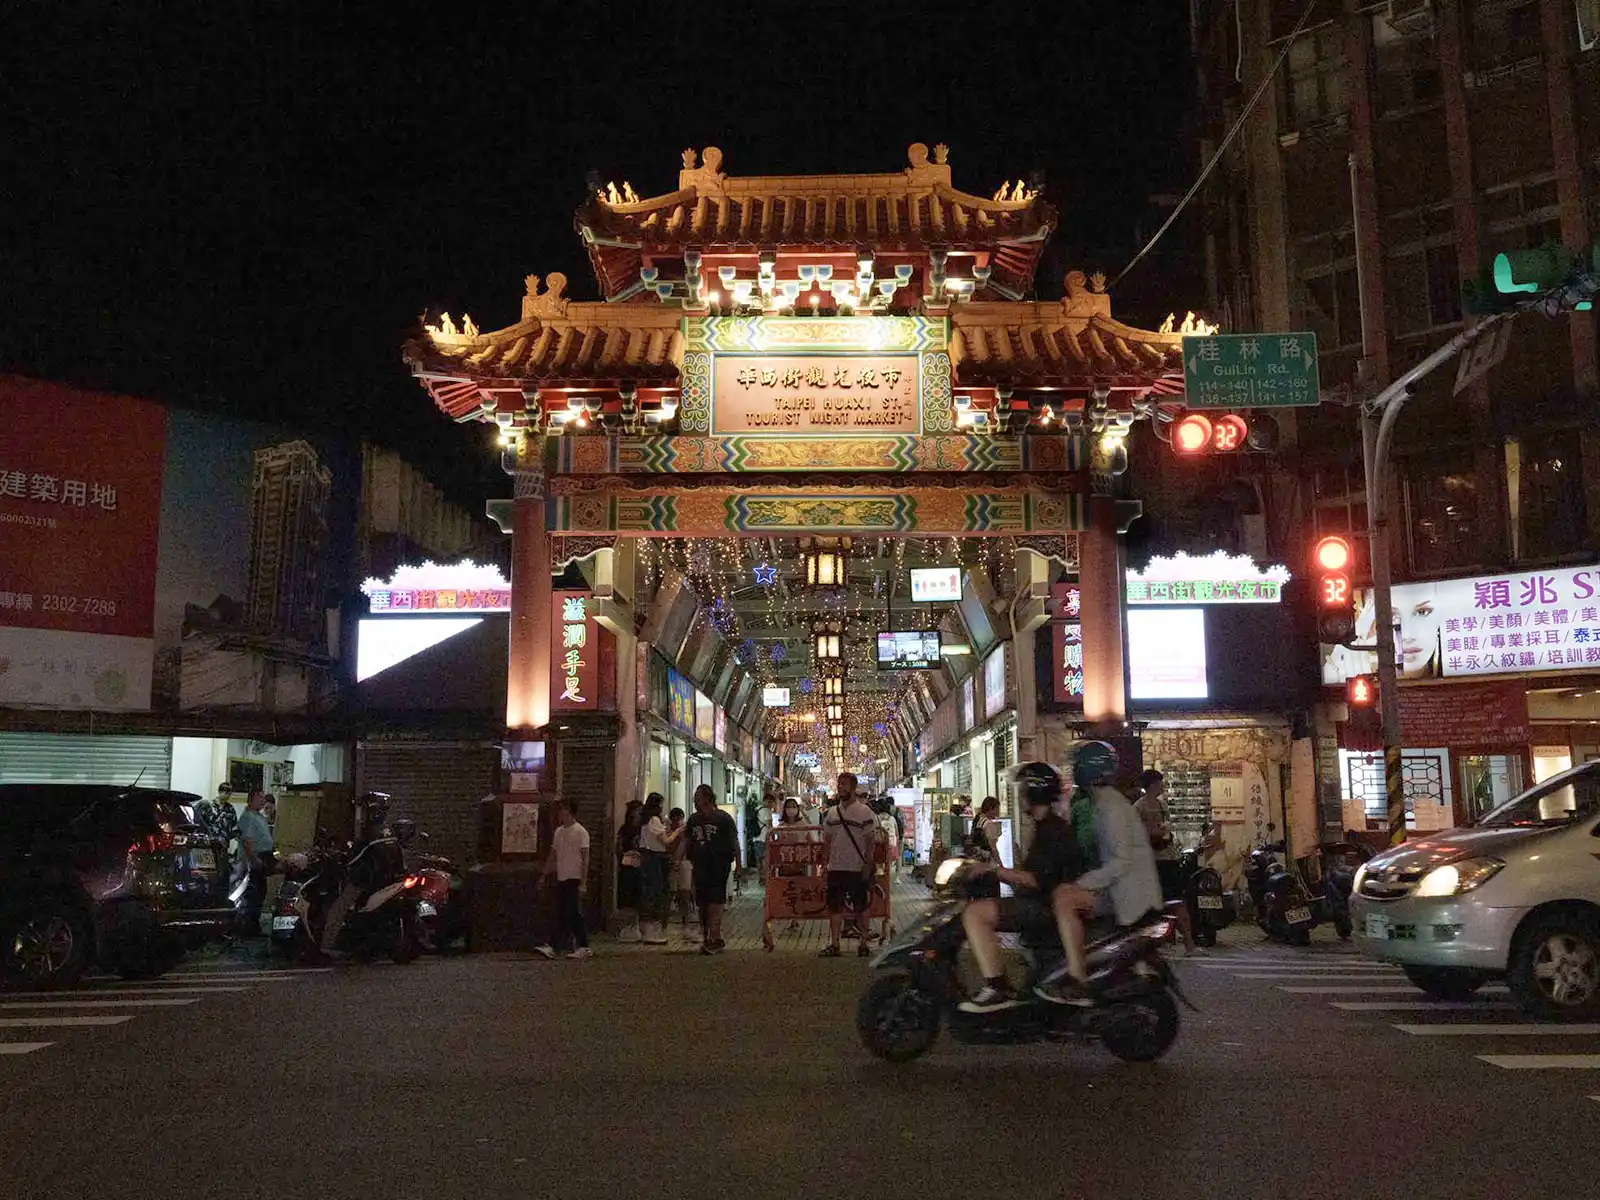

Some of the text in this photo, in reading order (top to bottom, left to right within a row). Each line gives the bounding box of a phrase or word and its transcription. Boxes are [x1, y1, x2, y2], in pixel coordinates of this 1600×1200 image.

[1197, 338, 1301, 361] 桂林路
[737, 365, 902, 390] 華西街觀光夜市
[1267, 363, 1290, 375] Rd.
[775, 398, 902, 411] TAIPEI HUAXI ST.
[746, 411, 904, 426] TOURIST NIGHT MARKET
[1215, 424, 1238, 448] 32
[0, 469, 119, 511] 建築用地
[1126, 580, 1281, 600] 華西街觀光夜市
[1325, 579, 1346, 602] 32
[1474, 571, 1600, 610] 穎兆 S
[560, 596, 587, 703] 滋潤手足
